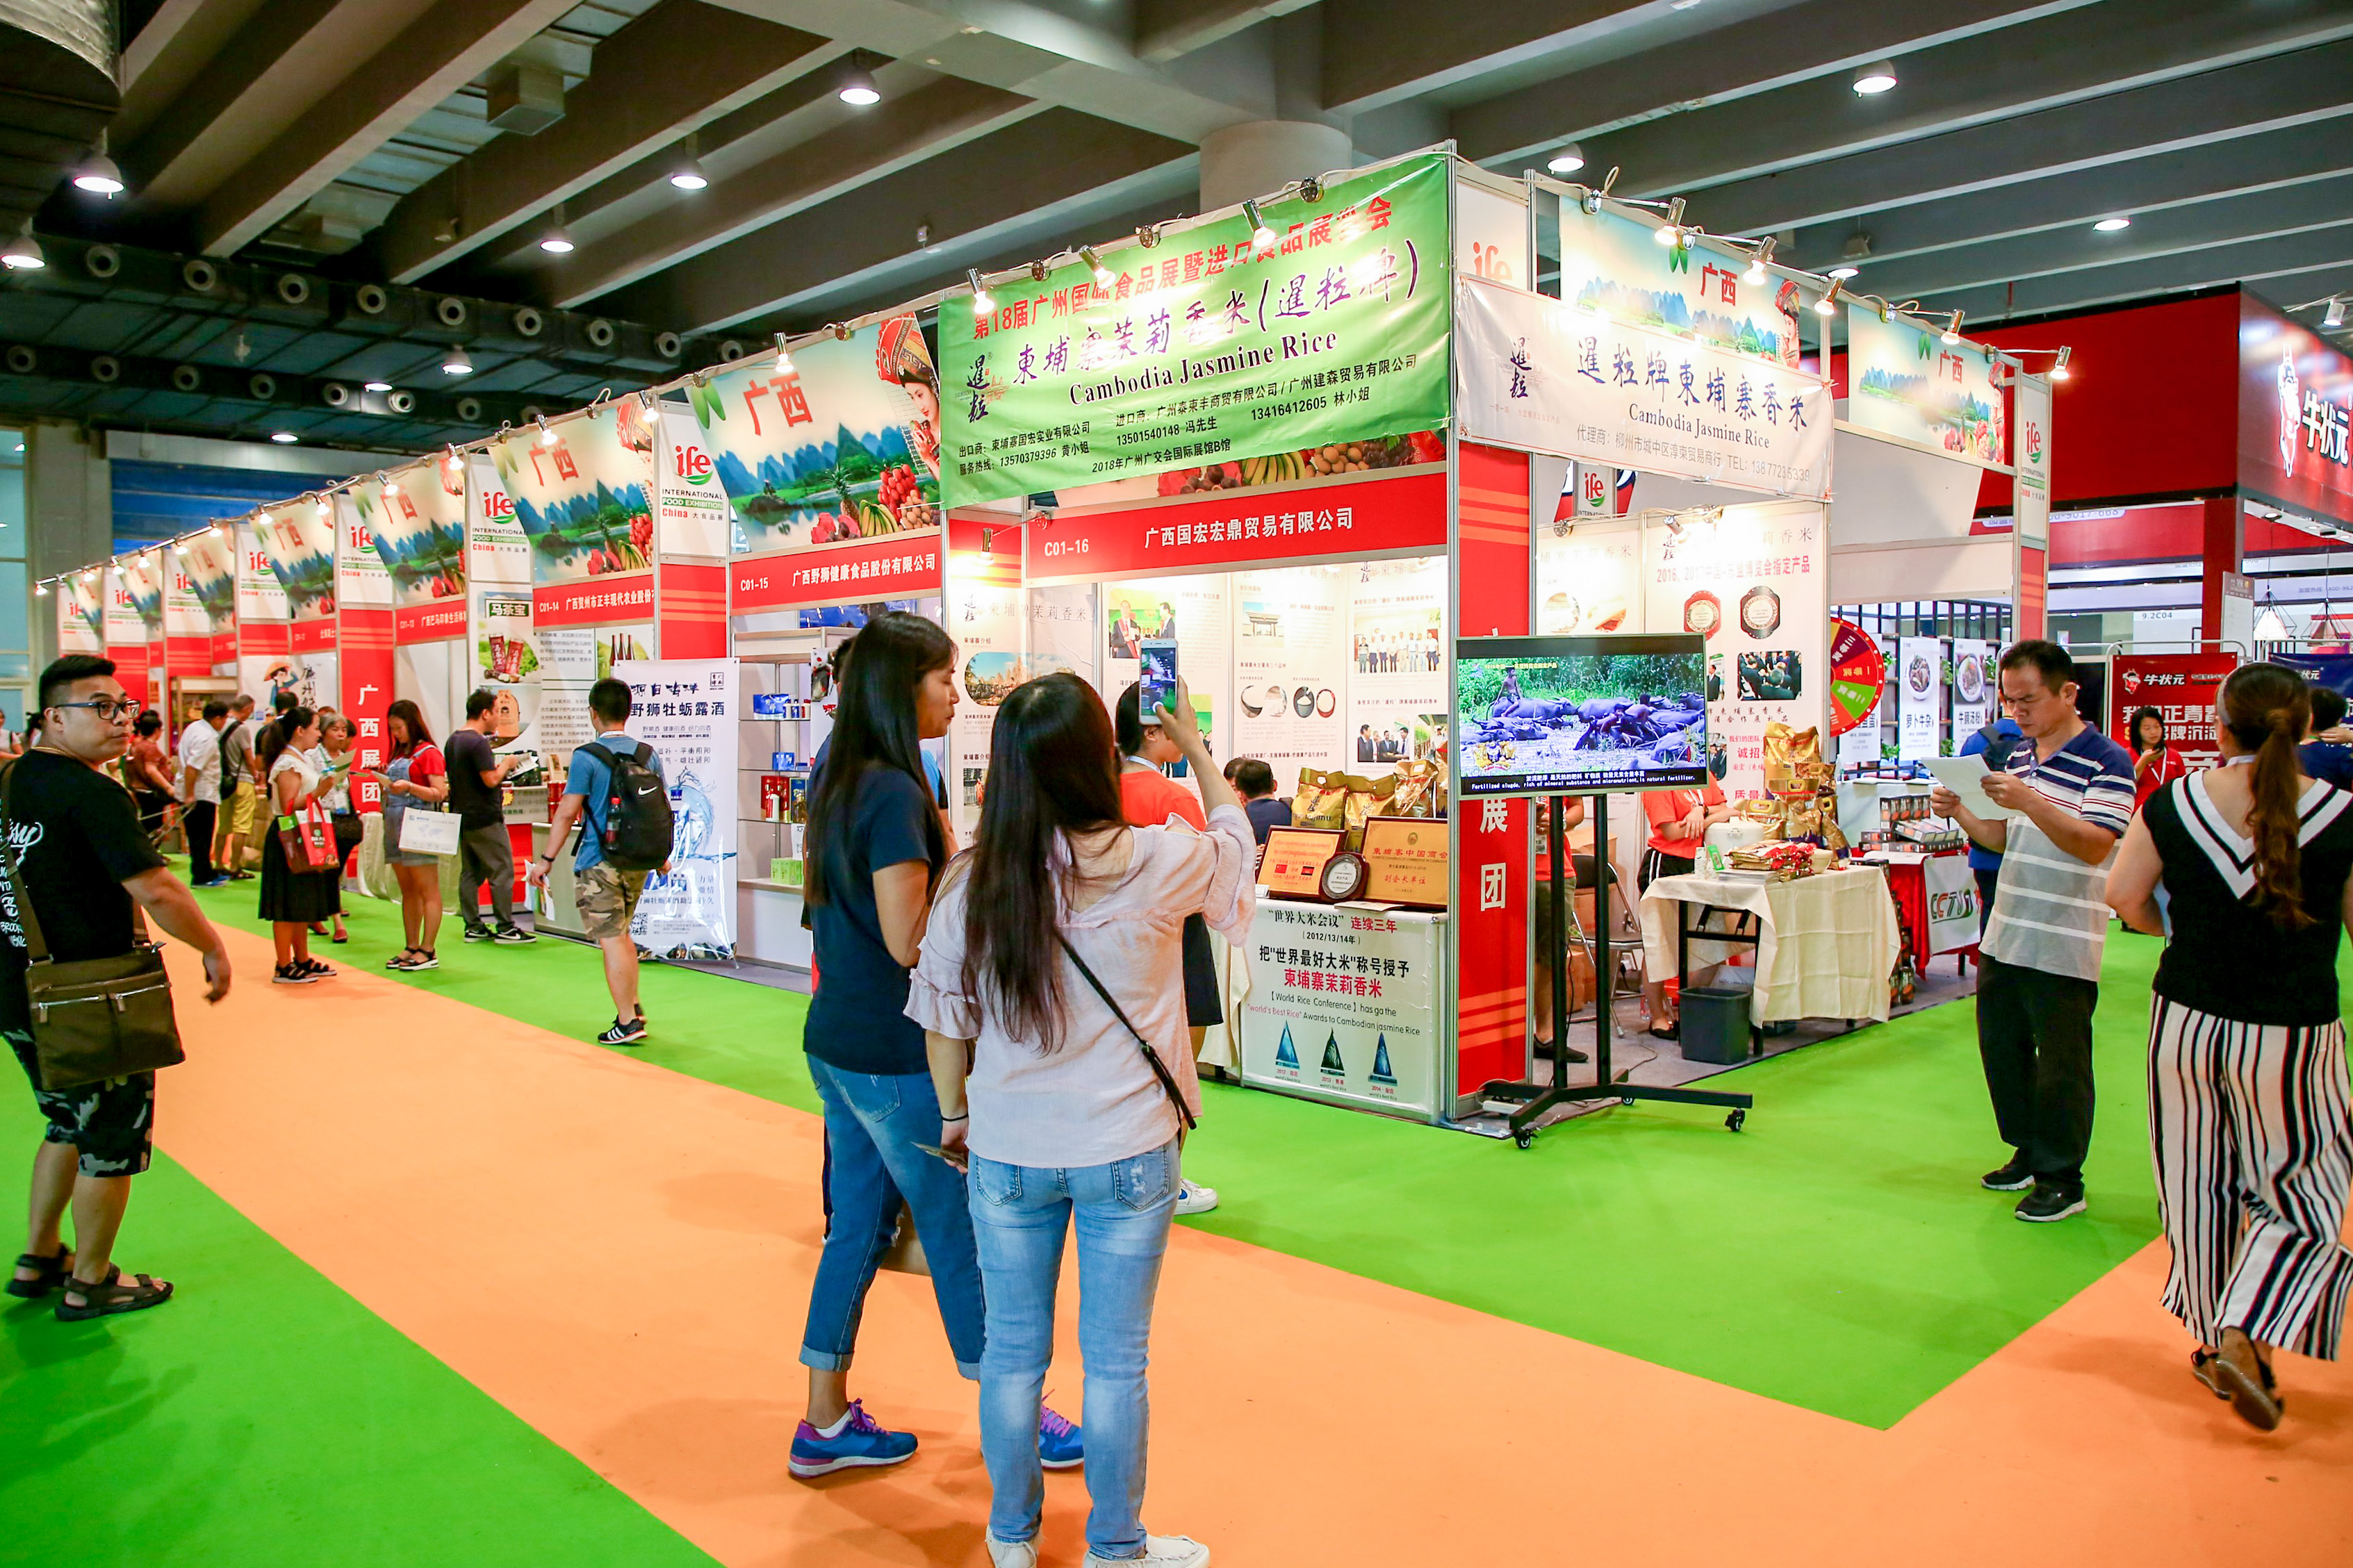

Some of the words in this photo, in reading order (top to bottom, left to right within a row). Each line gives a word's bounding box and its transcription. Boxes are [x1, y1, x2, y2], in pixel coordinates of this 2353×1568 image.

[1700, 263, 1737, 306] 广西
[1069, 357, 1174, 406] Cambodia
[1179, 340, 1275, 386] Jasmine
[1281, 330, 1338, 363] Rice
[1939, 350, 1964, 385] 广西
[743, 372, 813, 436] 广西
[1251, 397, 1327, 421] 13416412605
[1334, 386, 1370, 408] 林小姐
[1116, 424, 1180, 447] 13501540148
[1186, 416, 1218, 434] 冯先生
[1629, 403, 1692, 433] Cambodia
[1694, 422, 1741, 443] Jasmine
[1745, 429, 1770, 449] Rice
[2301, 389, 2349, 466] 牛状元
[527, 438, 579, 487] 广西
[675, 445, 711, 477] ife
[1061, 442, 1090, 459] 黄小姐
[1092, 438, 1231, 474] 2018年广州广交会国际展馆B馆
[662, 488, 723, 500] INTERNATIONAL
[1584, 472, 1604, 500] ife
[483, 492, 514, 517] ife
[662, 497, 684, 506] FOOD
[685, 499, 723, 509] EXHIBITION
[662, 509, 687, 518] China
[693, 512, 723, 521] 大食品展
[1044, 538, 1090, 556] C01-16
[1145, 507, 1354, 550] 广西国宏宏鼎贸易有限公司
[473, 543, 495, 552] China
[741, 577, 769, 592] C01-15
[792, 554, 936, 587] 广西野狮健康食品股份有限公司
[491, 604, 526, 616] 马茶宝
[539, 602, 559, 613] C01-14
[2142, 611, 2173, 620] 9.2C04
[2143, 673, 2185, 686] 牛状元
[630, 702, 725, 717] 野狮牡蛎露酒
[358, 684, 381, 802] 广西展团
[1737, 748, 1765, 759] 诚招
[1350, 916, 1397, 934] 连续三年
[1284, 968, 1383, 998] 柬埔寨茉莉香米
[1297, 995, 1311, 1005] Rice
[1360, 1003, 1373, 1013] has
[1385, 1005, 1397, 1017] the
[1272, 1008, 1286, 1016] Best
[1303, 1012, 1327, 1022] Awards
[1329, 1014, 1336, 1023] to
[1336, 1016, 1375, 1030] Cambodian
[1376, 1022, 1404, 1034] jasmine
[1405, 1025, 1420, 1036] Rice
